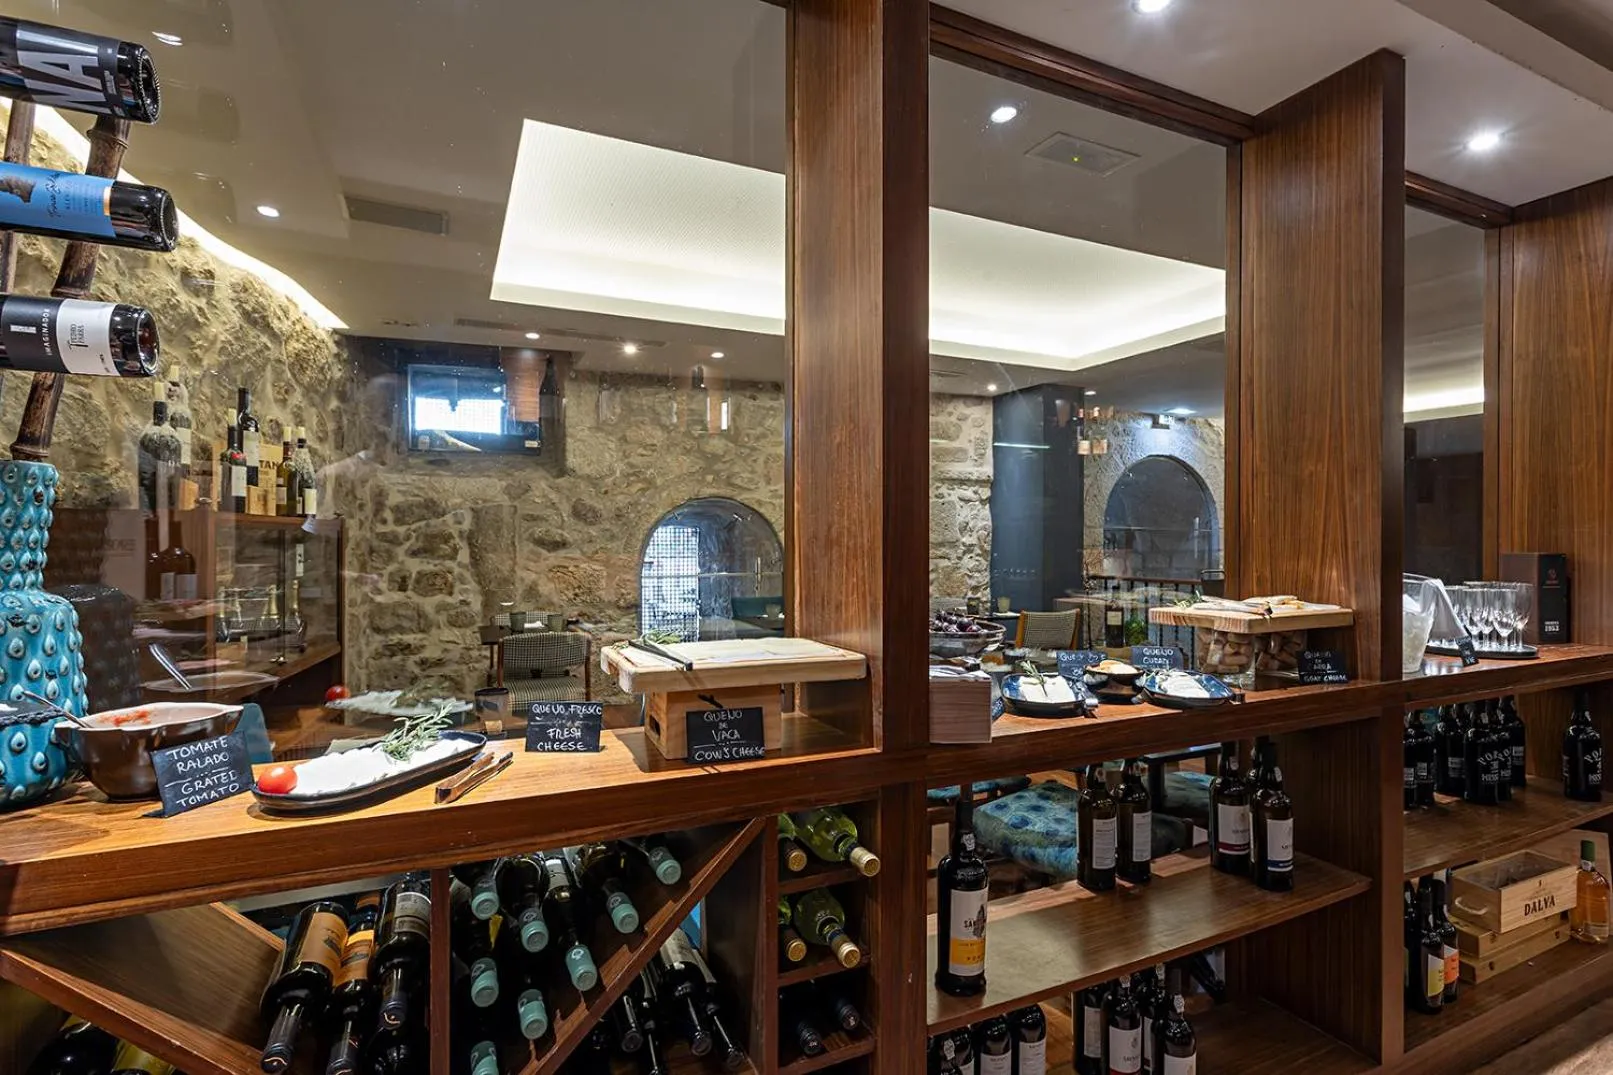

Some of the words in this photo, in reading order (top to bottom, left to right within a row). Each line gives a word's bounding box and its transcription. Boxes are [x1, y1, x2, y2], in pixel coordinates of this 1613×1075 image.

[703, 709, 742, 722] QUEIJO
[546, 728, 581, 739] FRESH
[712, 729, 740, 742] VACA
[165, 735, 228, 760] TOMATE
[537, 742, 587, 751] CHEESE
[732, 746, 765, 758] CHEESE
[176, 752, 229, 774] RALADO
[181, 770, 238, 795] GRATED
[175, 783, 240, 807] TOMATO
[1524, 895, 1556, 916] DALVA
